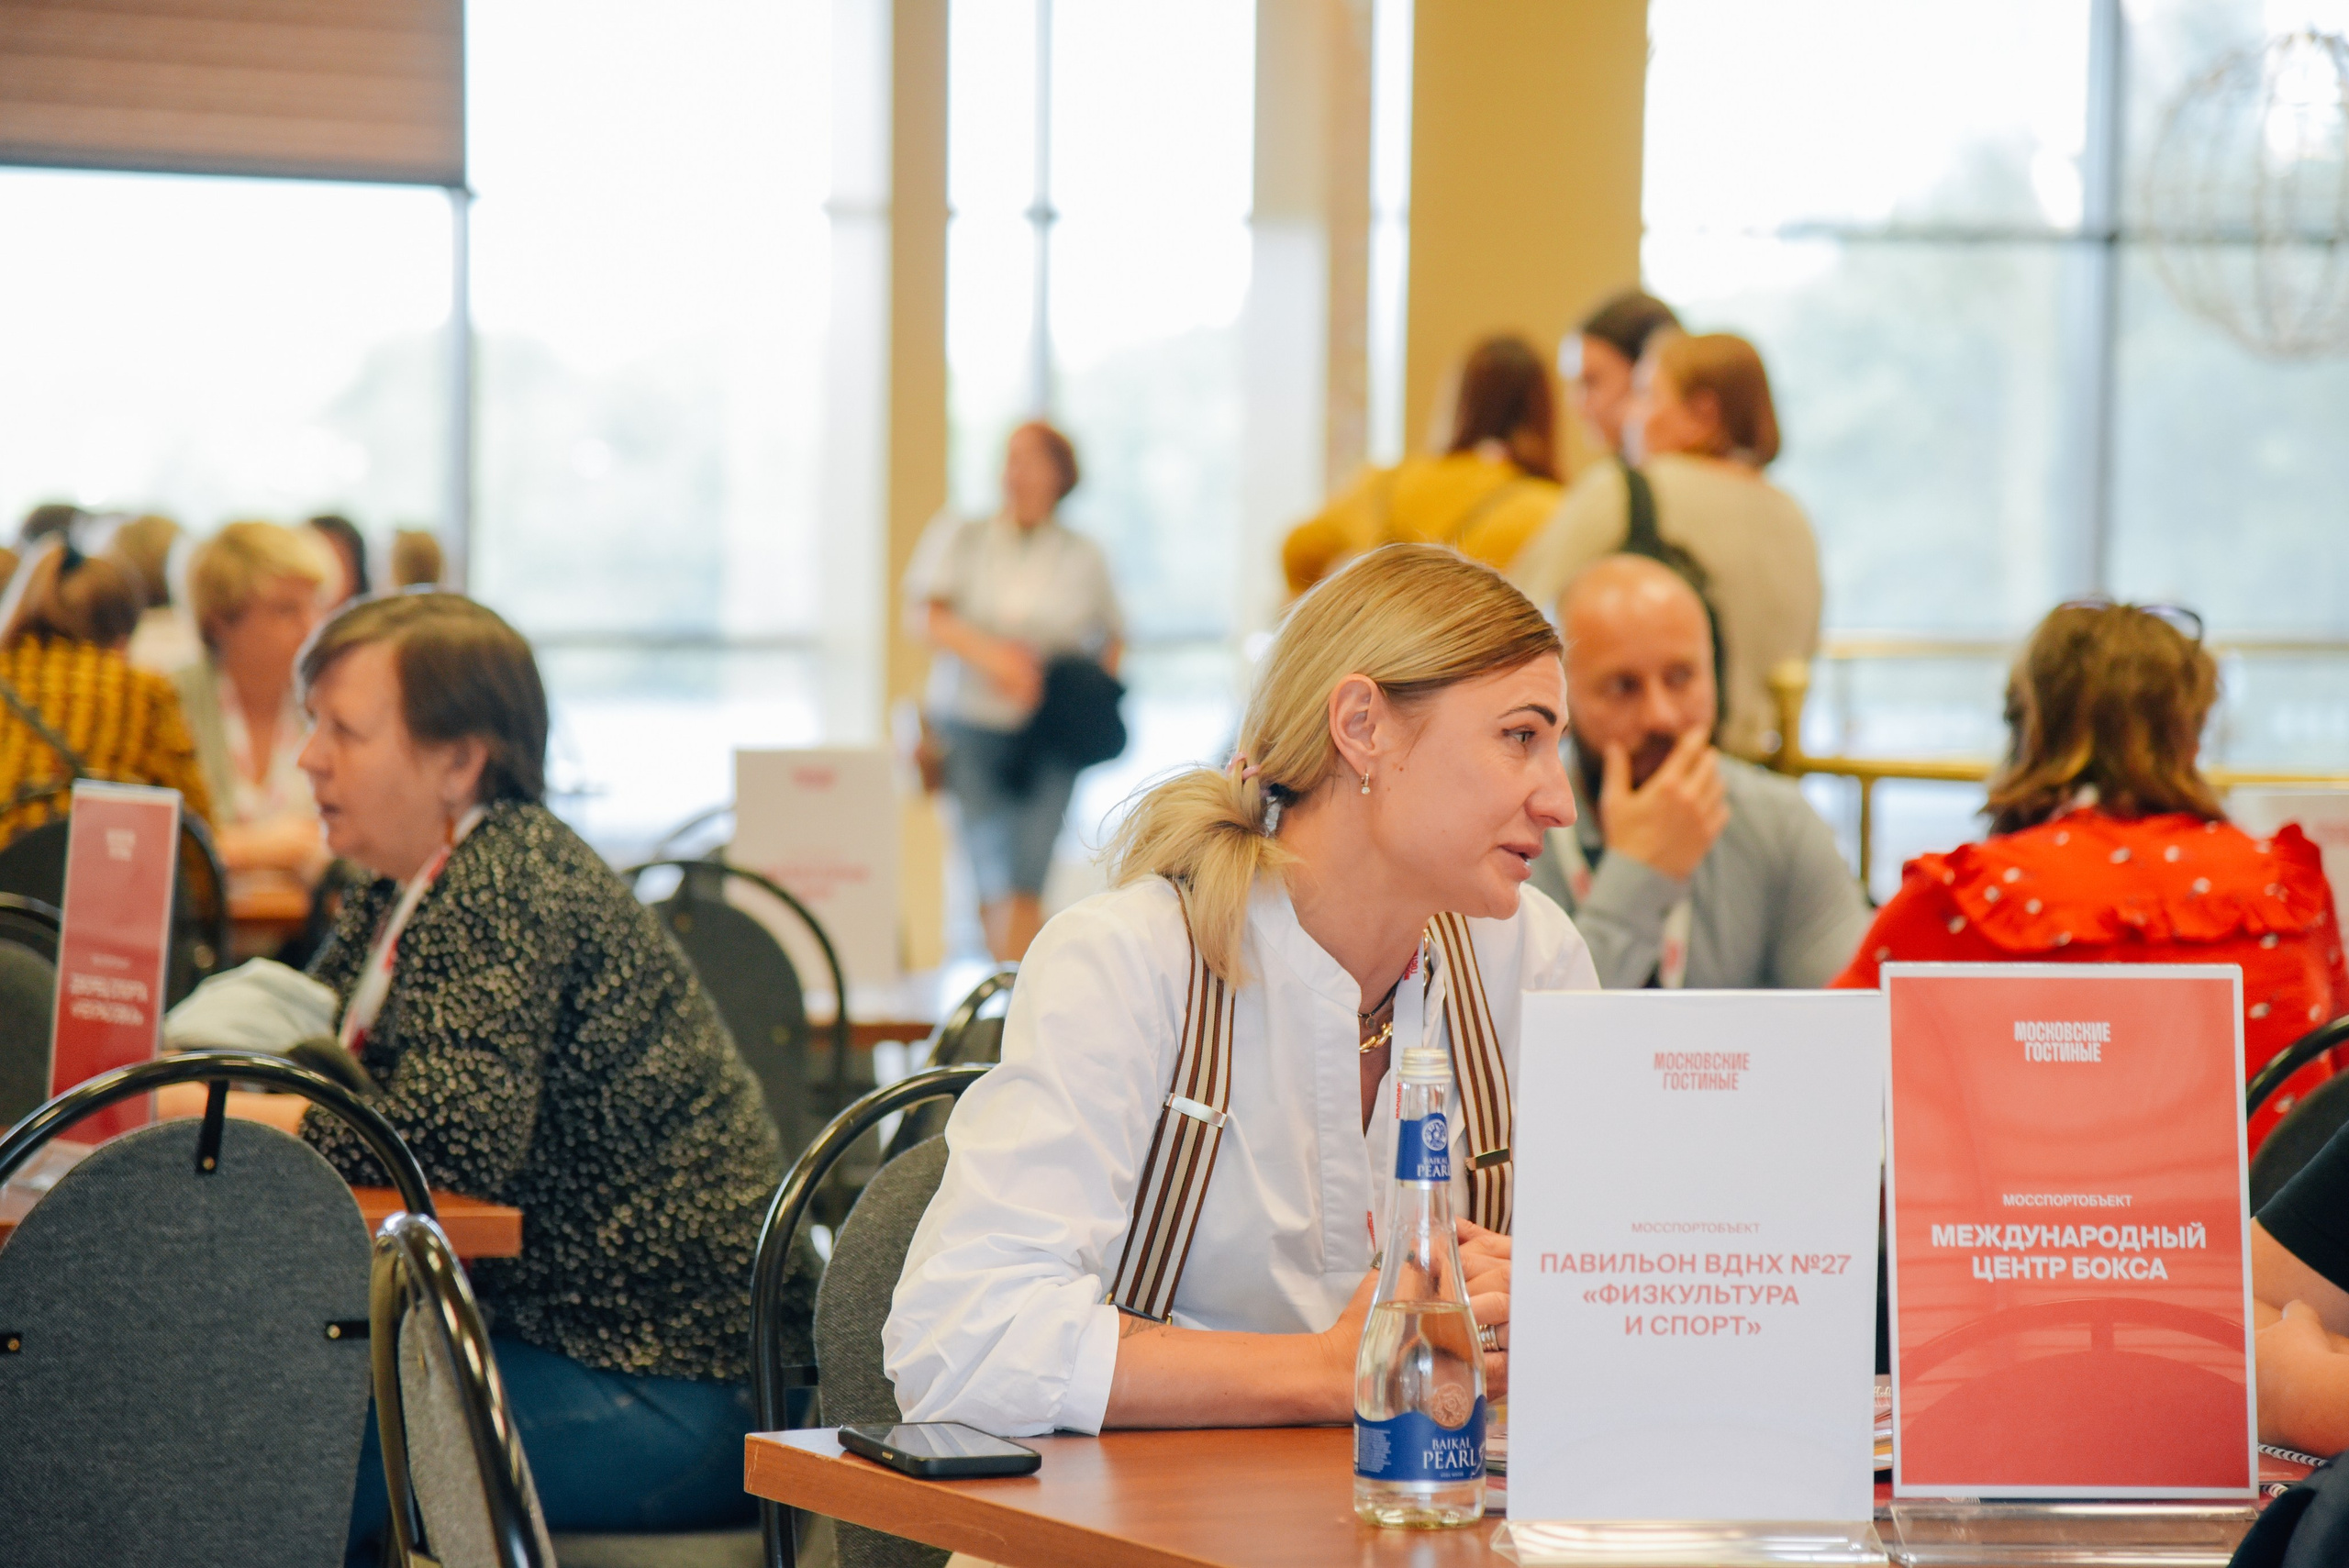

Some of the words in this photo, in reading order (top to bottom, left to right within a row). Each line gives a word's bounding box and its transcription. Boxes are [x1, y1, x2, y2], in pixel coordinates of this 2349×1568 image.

[2014, 1021, 2110, 1042] МОСКОВСКИЕ
[1654, 1052, 1750, 1071] МОСКОВСКИЕ
[2024, 1041, 2101, 1062] ГОСТИНЫЕ
[1663, 1072, 1739, 1090] ГОСТИНЫЕ
[2003, 1194, 2132, 1207] МОССПОРТОБЪЕКТ
[1631, 1222, 1760, 1234] МОССПОРТОБЪЕКТ
[1932, 1222, 2206, 1251] МЕЖДУНАРОДНЫЙ
[1541, 1253, 1697, 1273] ПАВИЛЬОН
[1705, 1253, 1784, 1277] ВДНХ
[1791, 1254, 1852, 1274] №27
[1973, 1255, 2066, 1283] ЦЕНТР
[2072, 1257, 2168, 1280] БОКСА
[1583, 1283, 1799, 1306] «ФИЗКУЛЬТУРА
[1625, 1315, 1642, 1335] И
[1650, 1315, 1762, 1336] СПОРТ»
[1432, 1437, 1471, 1450] BAIKAL
[1423, 1450, 1476, 1469] PEARL
